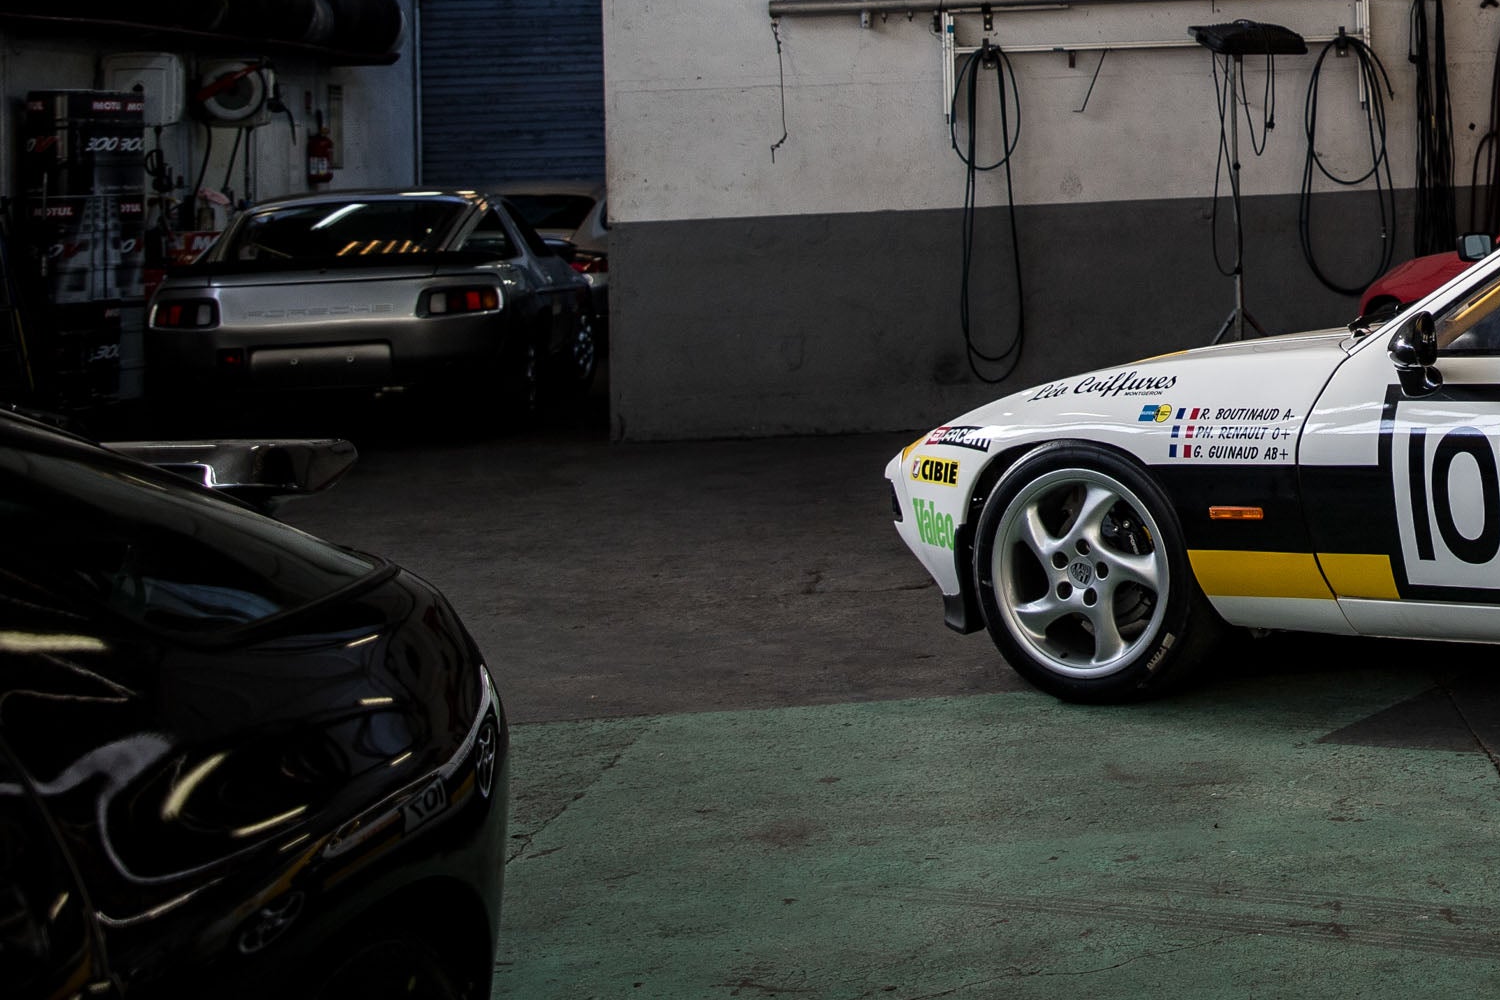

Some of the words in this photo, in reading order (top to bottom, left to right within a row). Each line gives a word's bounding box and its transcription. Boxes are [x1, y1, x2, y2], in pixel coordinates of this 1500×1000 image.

[1073, 371, 1177, 398] Coiffures
[1200, 408, 1210, 420] R.
[1215, 408, 1279, 420] BOUTINAUD
[1283, 408, 1295, 420] A-
[1195, 426, 1213, 438] PH.
[1218, 426, 1268, 440] RENAULT
[1194, 445, 1204, 458] G.
[1208, 445, 1259, 459] GUINAUD
[912, 497, 955, 551] Valeo
